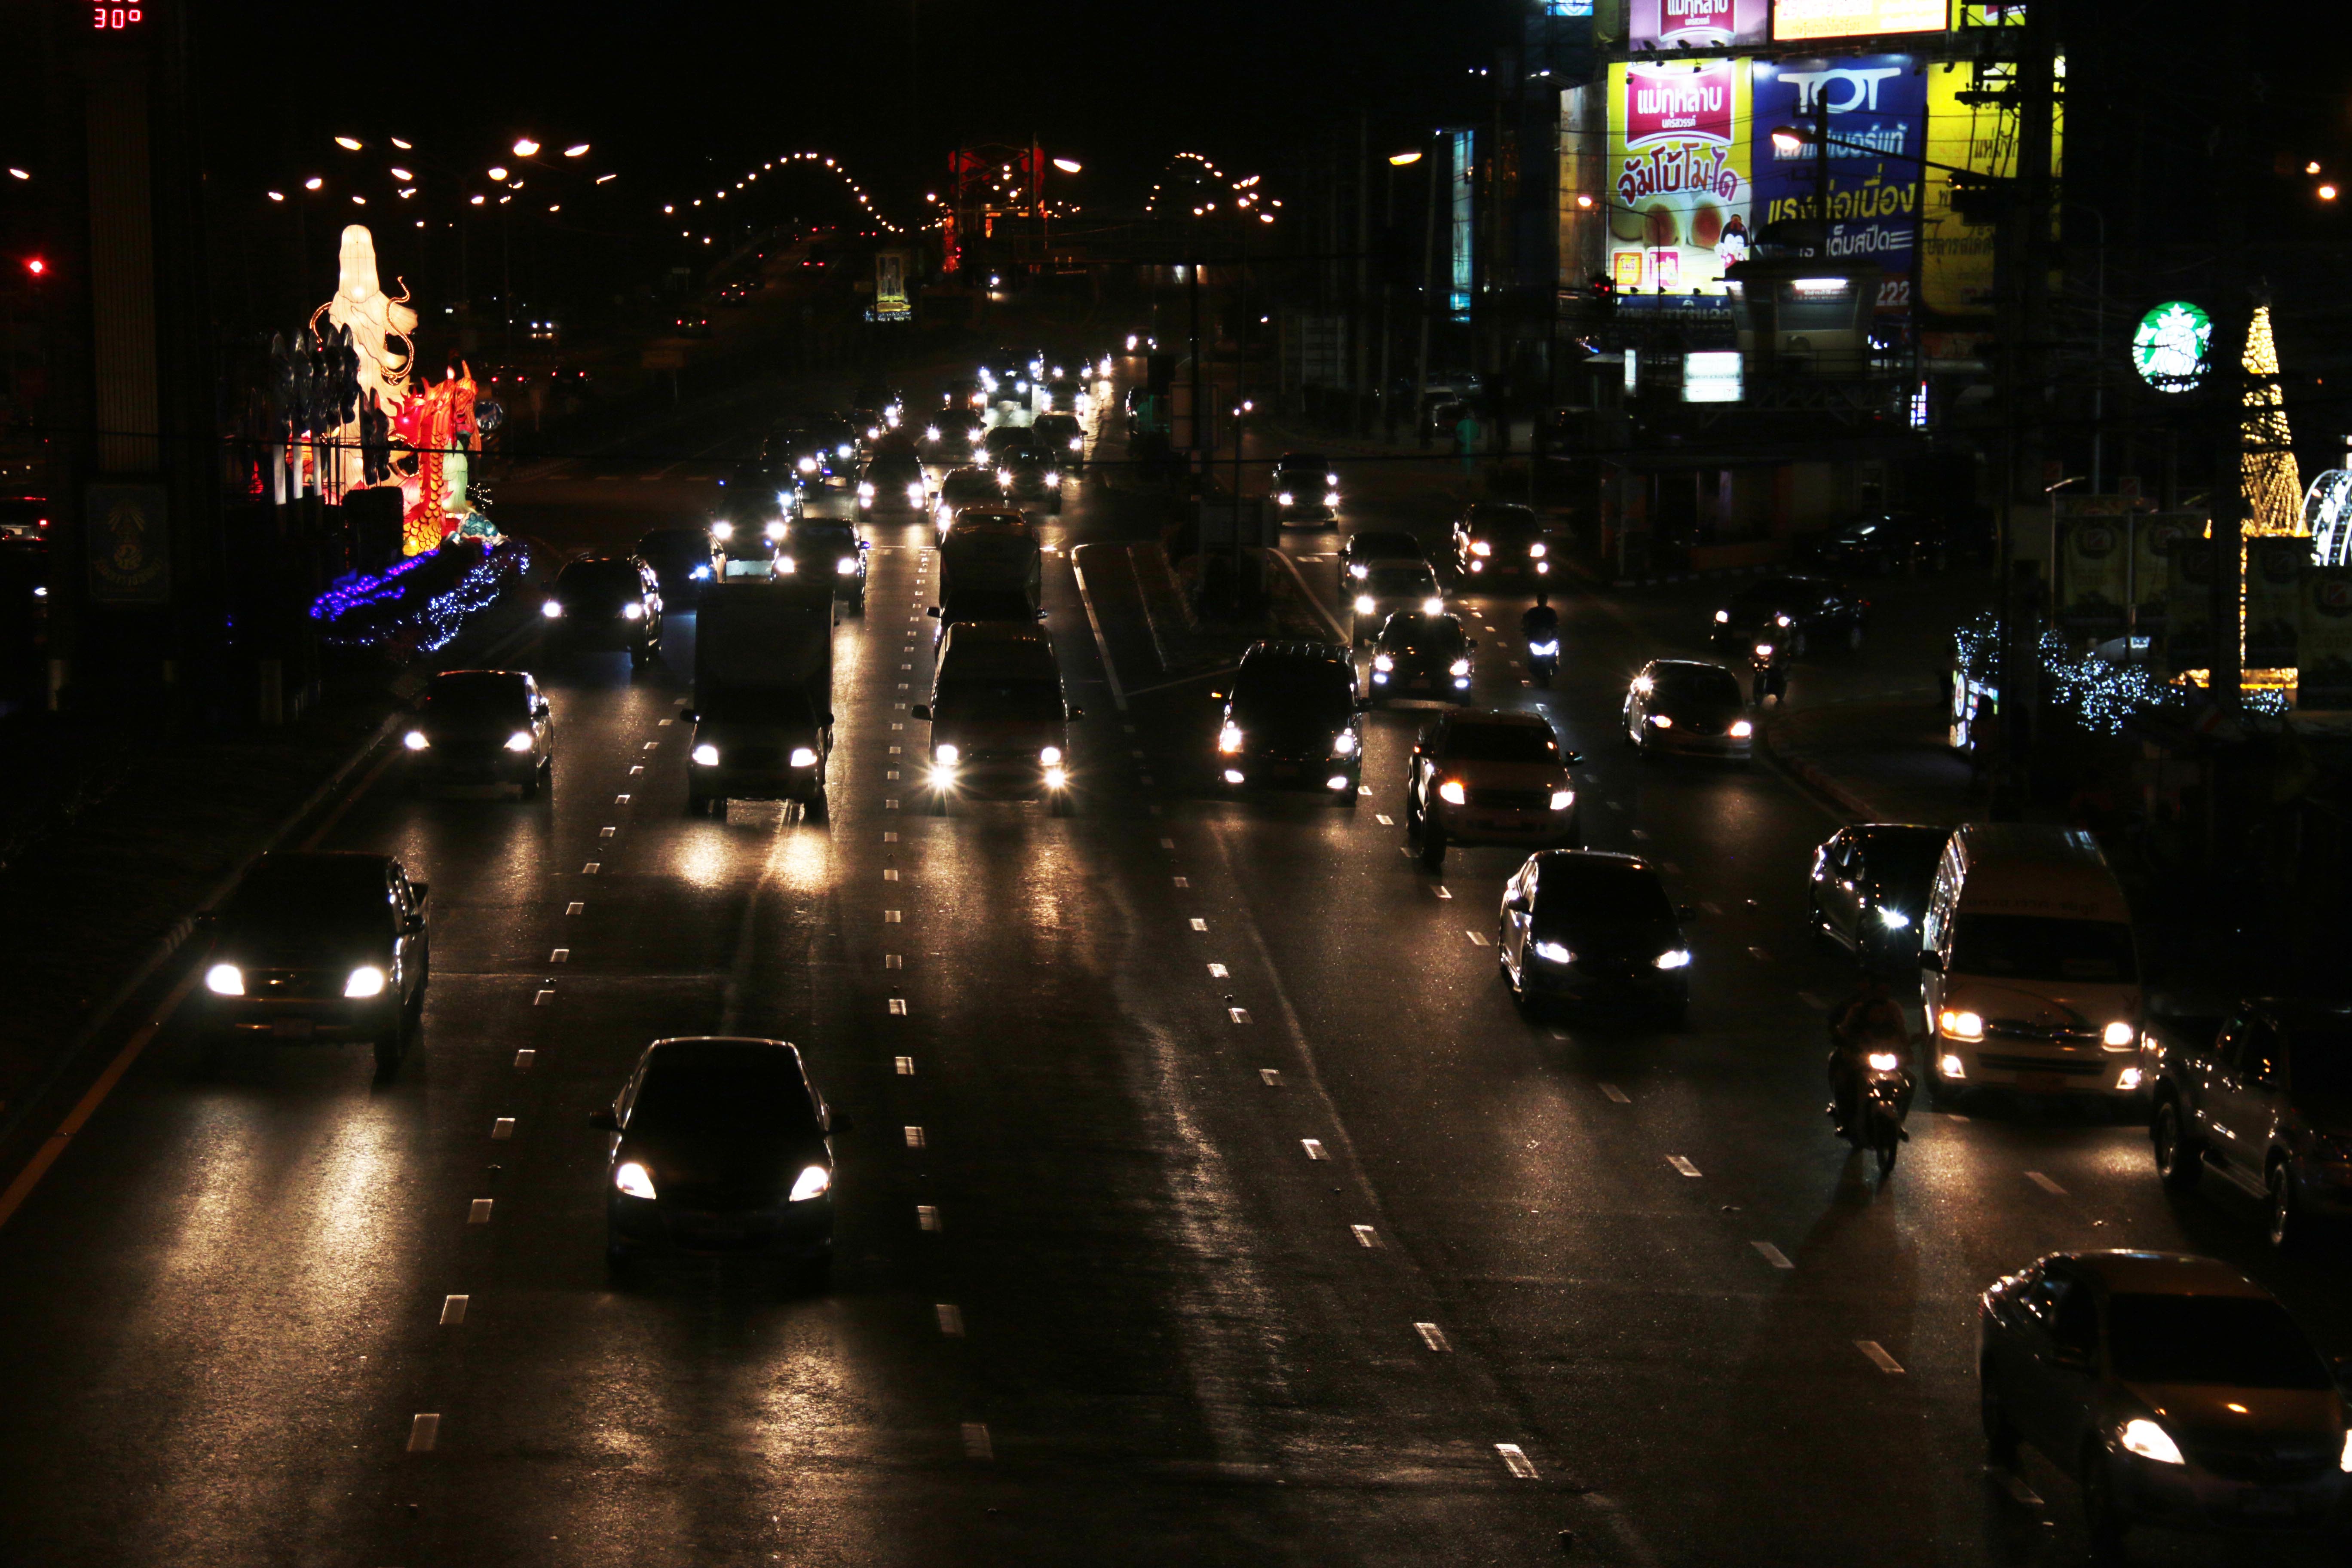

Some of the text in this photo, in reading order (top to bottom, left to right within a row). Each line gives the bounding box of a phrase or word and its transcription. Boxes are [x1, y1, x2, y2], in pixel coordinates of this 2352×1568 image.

[1667, 0, 1728, 18] แมกุหลาบ
[1637, 82, 1722, 118] แม่กุหลาบ
[1777, 67, 1902, 114] TOT
[1662, 115, 1696, 128] นครสวรรค์
